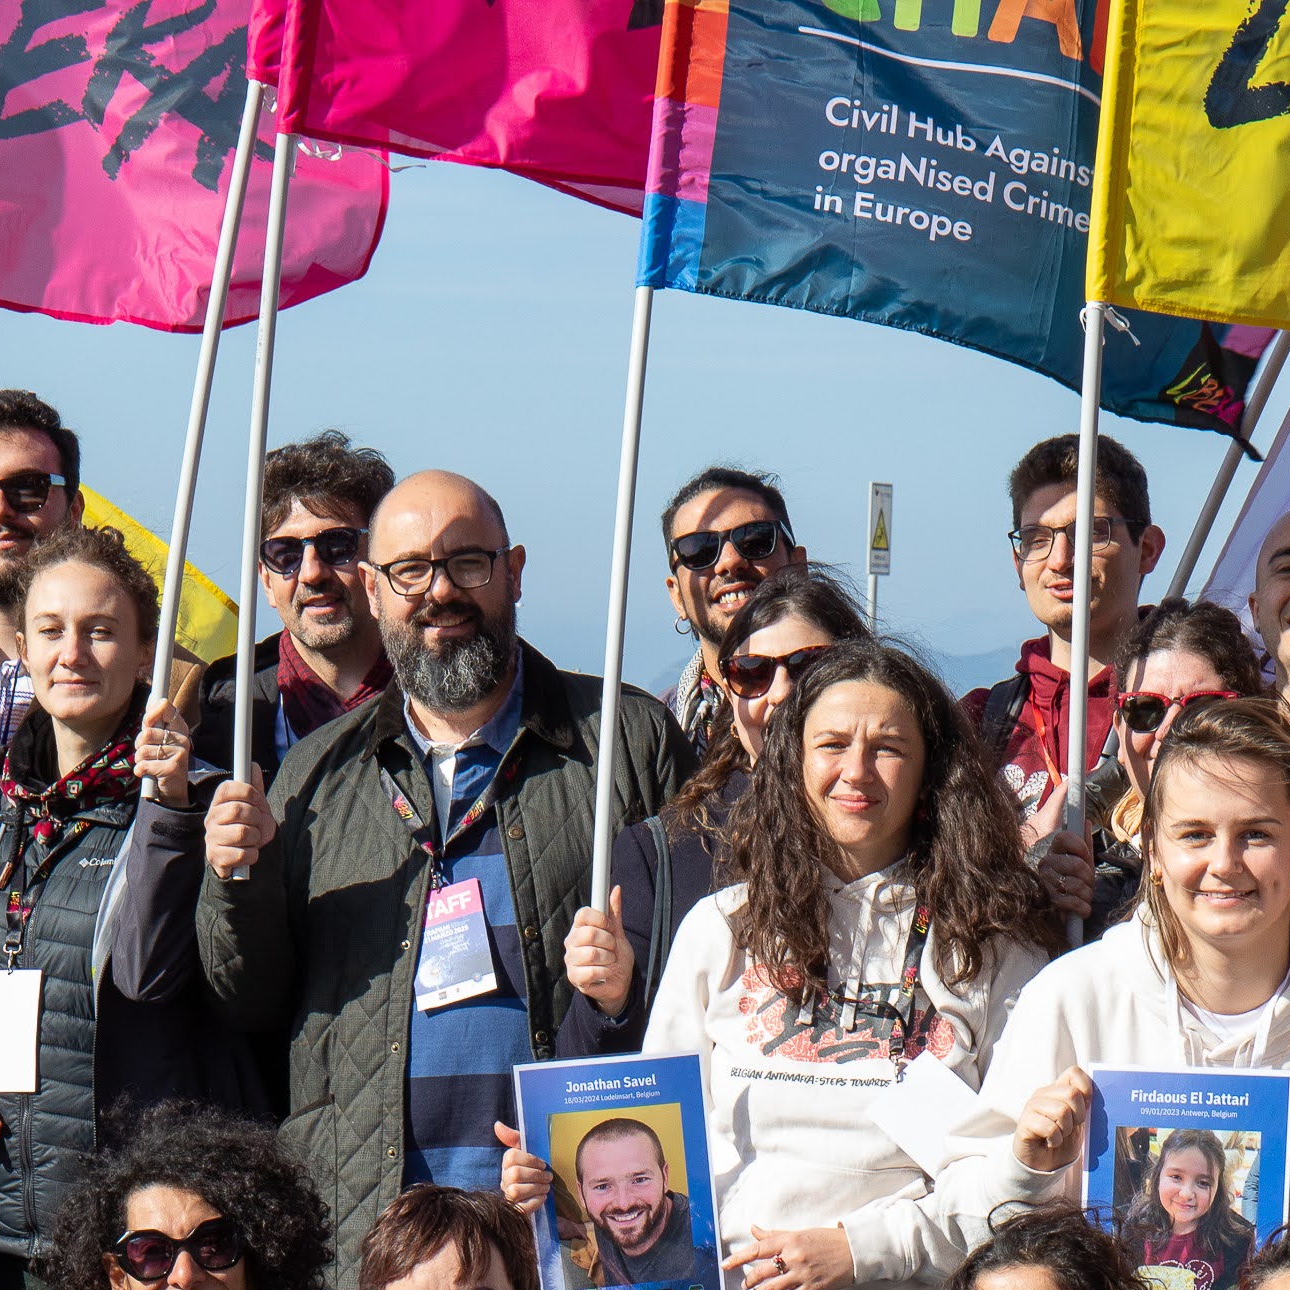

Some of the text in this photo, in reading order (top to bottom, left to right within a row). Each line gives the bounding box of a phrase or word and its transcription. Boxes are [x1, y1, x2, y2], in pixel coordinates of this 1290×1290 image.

[825, 96, 1095, 188] Civil Hub Agains
[818, 150, 1091, 233] orgaNised Crime
[813, 185, 973, 242] in Europe
[89, 857, 117, 867] Colum
[425, 889, 473, 921] TAFF
[566, 1074, 657, 1093] Jonathan Savel
[564, 1095, 600, 1105] 18/03/2024
[636, 1091, 661, 1100] Belgium
[1131, 1089, 1249, 1106] Firdaous El Jattari
[1140, 1107, 1238, 1119] 09/01/2023 Antwerp, Belgium
